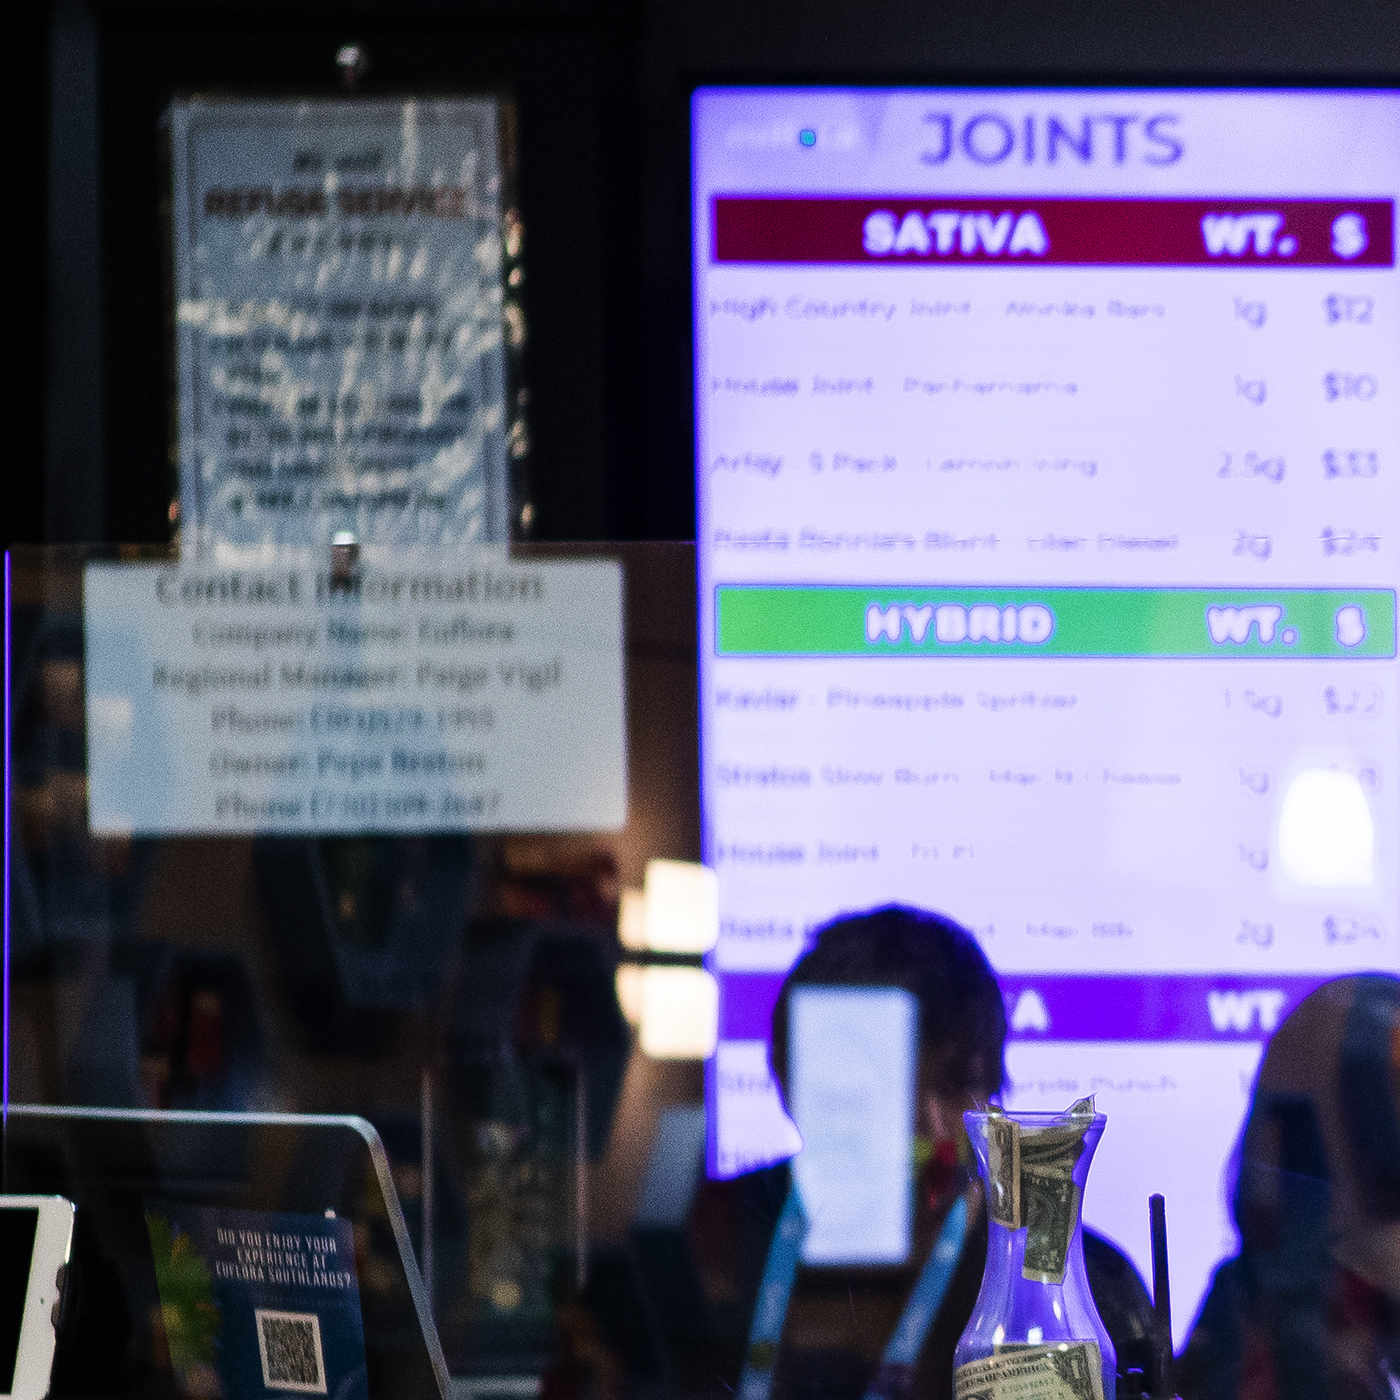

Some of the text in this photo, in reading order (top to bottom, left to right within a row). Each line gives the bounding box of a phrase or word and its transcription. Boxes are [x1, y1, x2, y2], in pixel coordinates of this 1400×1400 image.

[919, 111, 1186, 167] JOINTS
[862, 209, 1050, 257] SATIVA
[1201, 210, 1298, 258] WT.
[863, 603, 1056, 646] HYBRID
[1204, 603, 1299, 648] WT.
[237, 1247, 307, 1269] EXPERIENCE
[305, 1235, 338, 1254] YOUR
